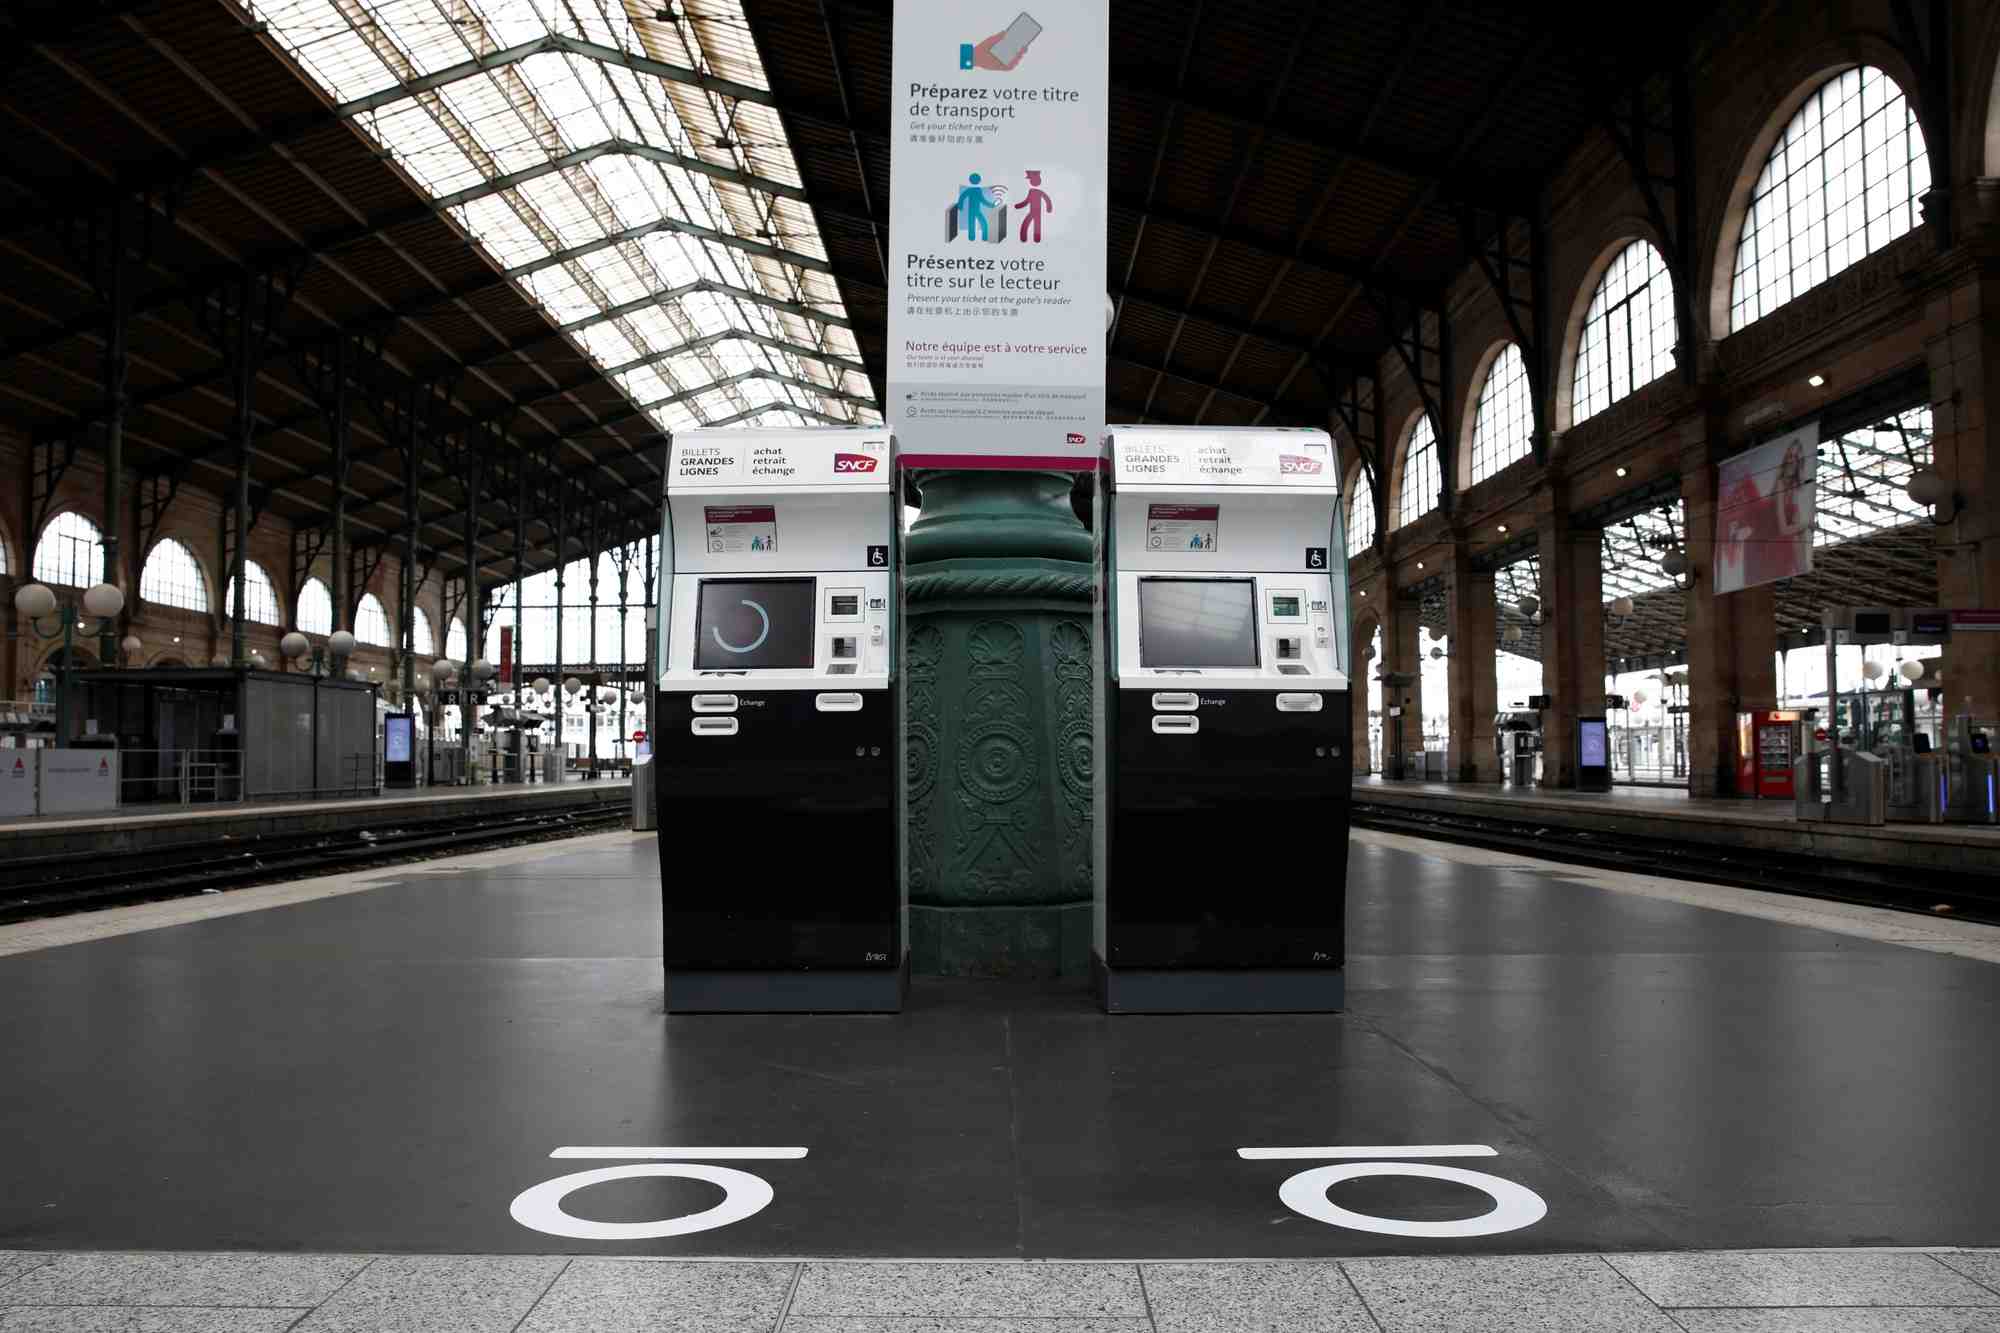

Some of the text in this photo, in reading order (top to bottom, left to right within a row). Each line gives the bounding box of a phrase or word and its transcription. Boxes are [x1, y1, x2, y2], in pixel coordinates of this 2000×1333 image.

[910, 82, 1080, 102] Préparez votre titre
[910, 102, 1016, 120] de transport
[910, 121, 999, 134] Get your ticket ready
[907, 254, 1045, 271] Présentez votre
[907, 273, 1061, 290] titre sur le lecteur
[907, 293, 939, 304] Present
[941, 296, 961, 305] your
[962, 295, 986, 304] ticket
[988, 296, 998, 304] at
[1000, 295, 1014, 304] the
[1043, 296, 1072, 306] reader
[906, 340, 1088, 355] Notre équipe est à votre service
[682, 448, 720, 456] BILLETS
[753, 447, 783, 456] achat
[1197, 446, 1228, 455] achat
[681, 457, 735, 466] GRANDES
[752, 456, 787, 465] retrait
[1125, 455, 1180, 464] GRANDES
[1198, 456, 1232, 465] retrait
[835, 459, 875, 472] SNCF
[1126, 464, 1166, 473] LIGNES
[1199, 465, 1243, 475] échange
[1280, 461, 1320, 473] SNCF
[680, 466, 719, 476] LIGNES
[752, 466, 796, 477] échange
